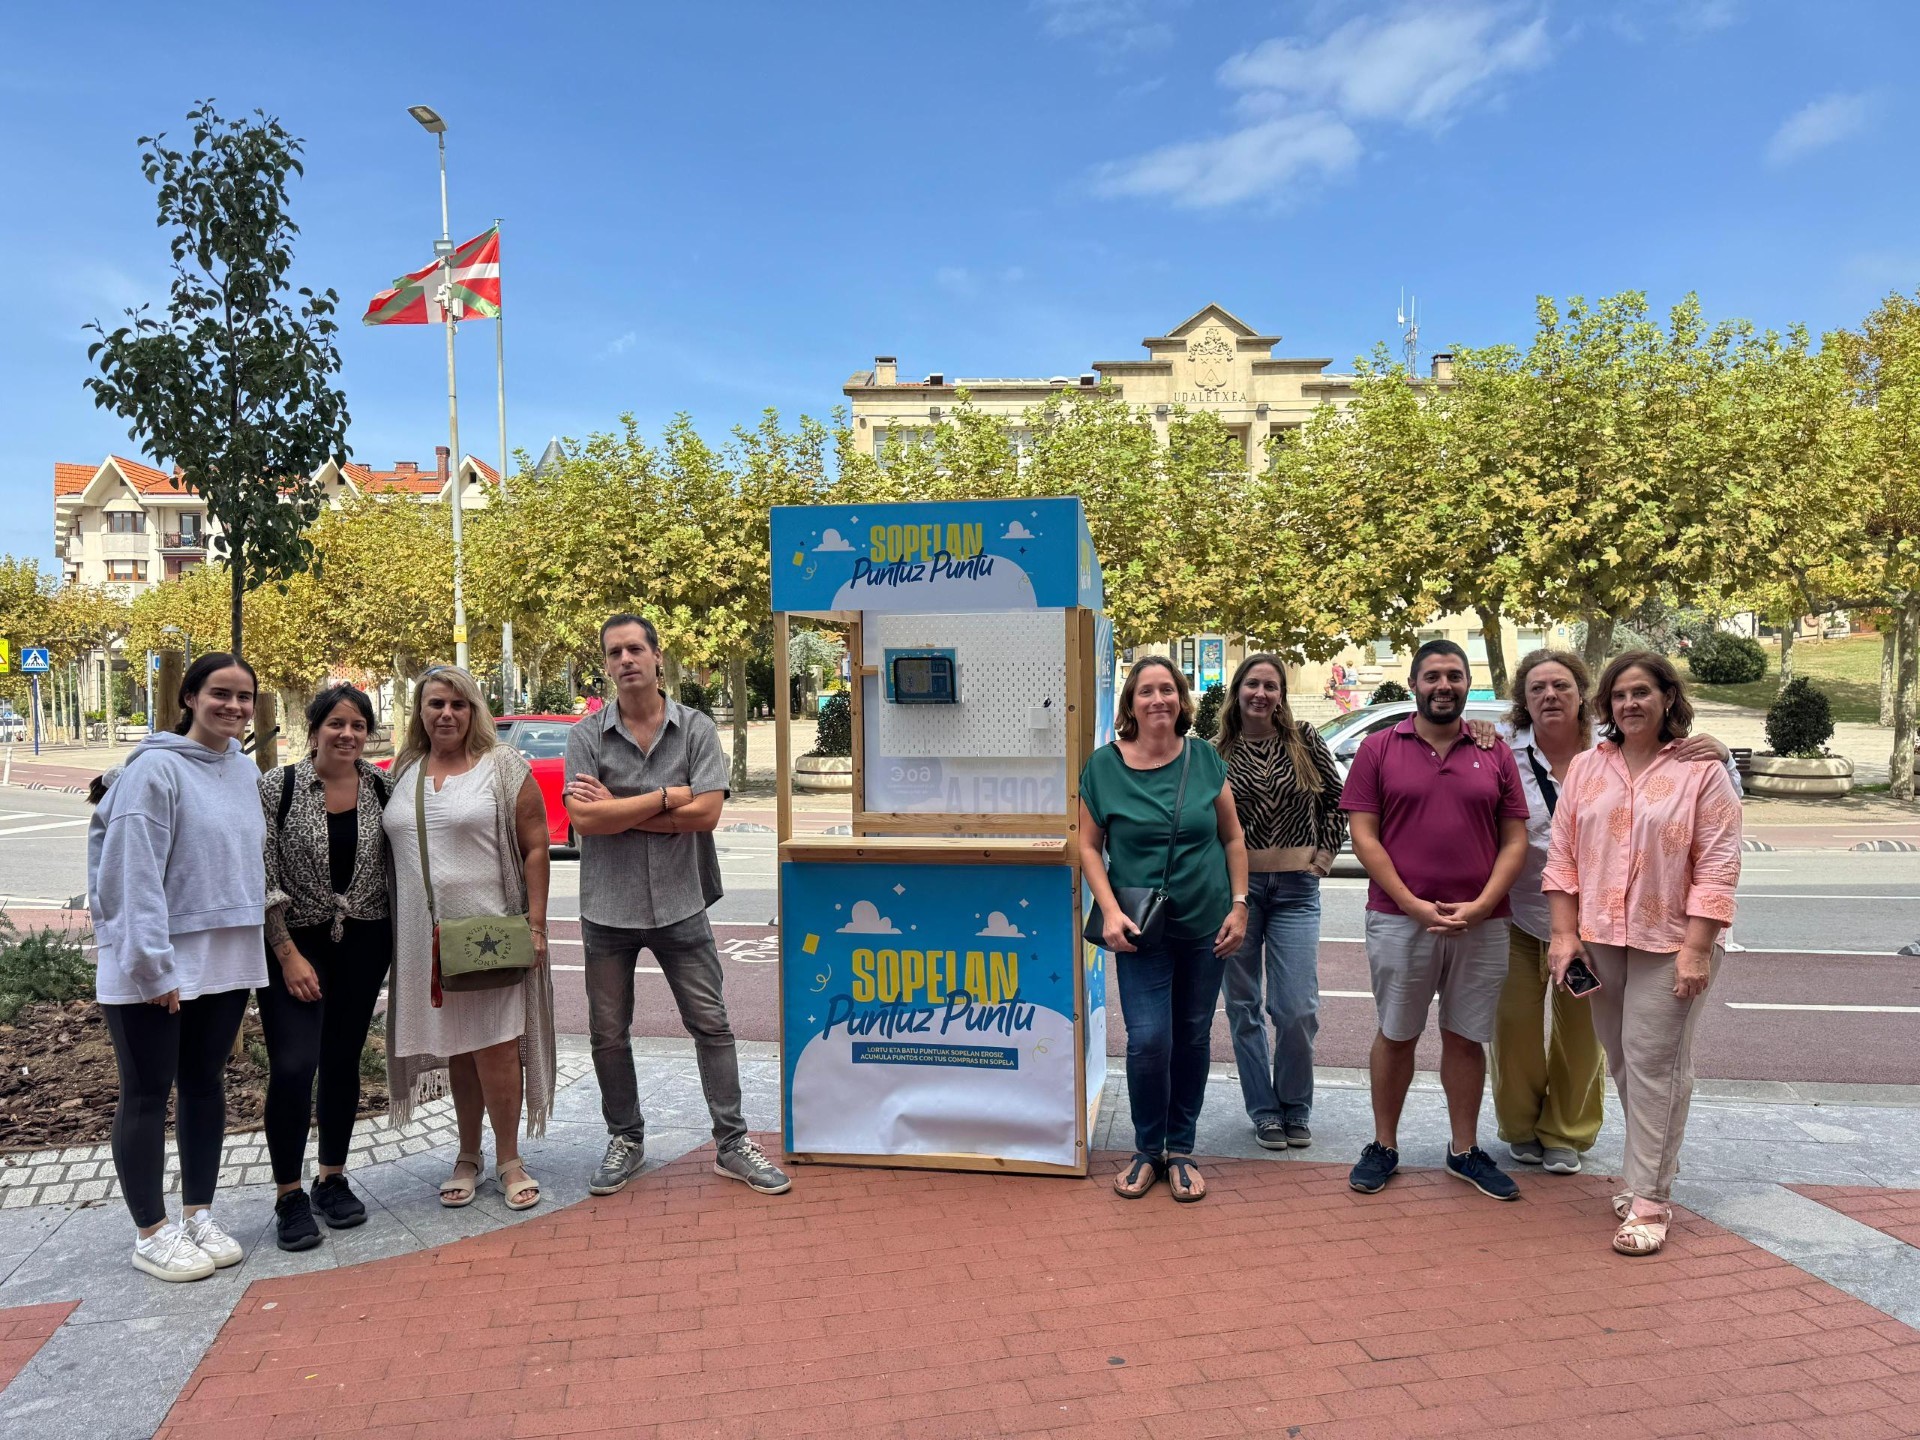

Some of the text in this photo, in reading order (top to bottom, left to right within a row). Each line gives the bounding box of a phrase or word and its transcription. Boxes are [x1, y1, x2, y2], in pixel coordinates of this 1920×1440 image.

[1174, 391, 1248, 402] UDALETXEA
[870, 523, 983, 563] SOPELAN
[850, 547, 995, 589] Puntuz Puntu
[469, 925, 503, 935] VINTAGE
[500, 942, 511, 960] STAR
[473, 957, 497, 966] SINCE
[852, 949, 1019, 1006] SOPELAN
[822, 987, 1036, 1040] Puntuz Puntu
[948, 1056, 979, 1064] COMPRAS
